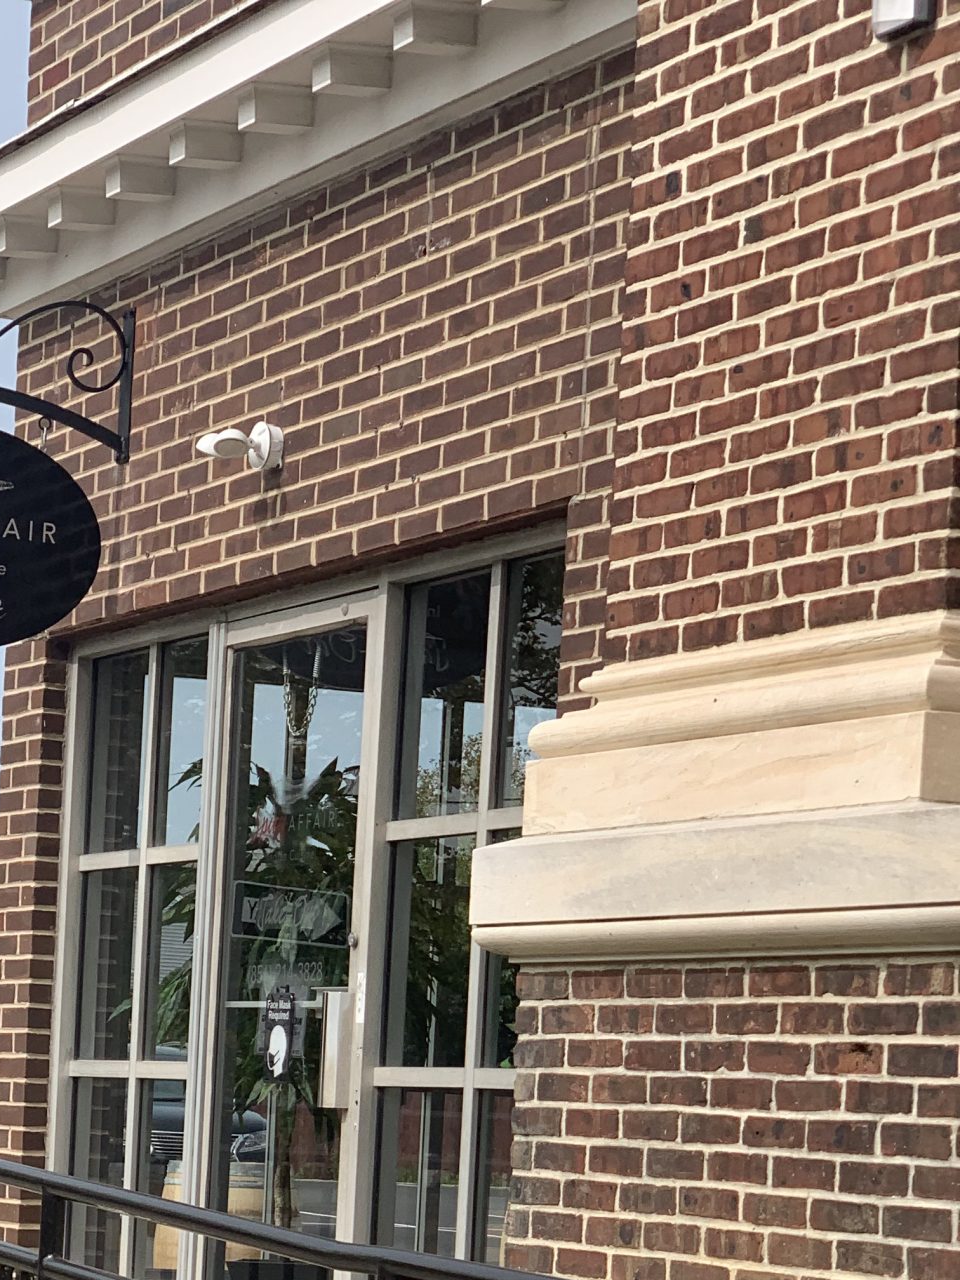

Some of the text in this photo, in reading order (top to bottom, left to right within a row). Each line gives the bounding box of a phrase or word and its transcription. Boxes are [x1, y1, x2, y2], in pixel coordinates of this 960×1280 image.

[288, 810, 337, 831] AFFAIR
[268, 1000, 291, 1009] Face Mask
[269, 1010, 290, 1021] Required
